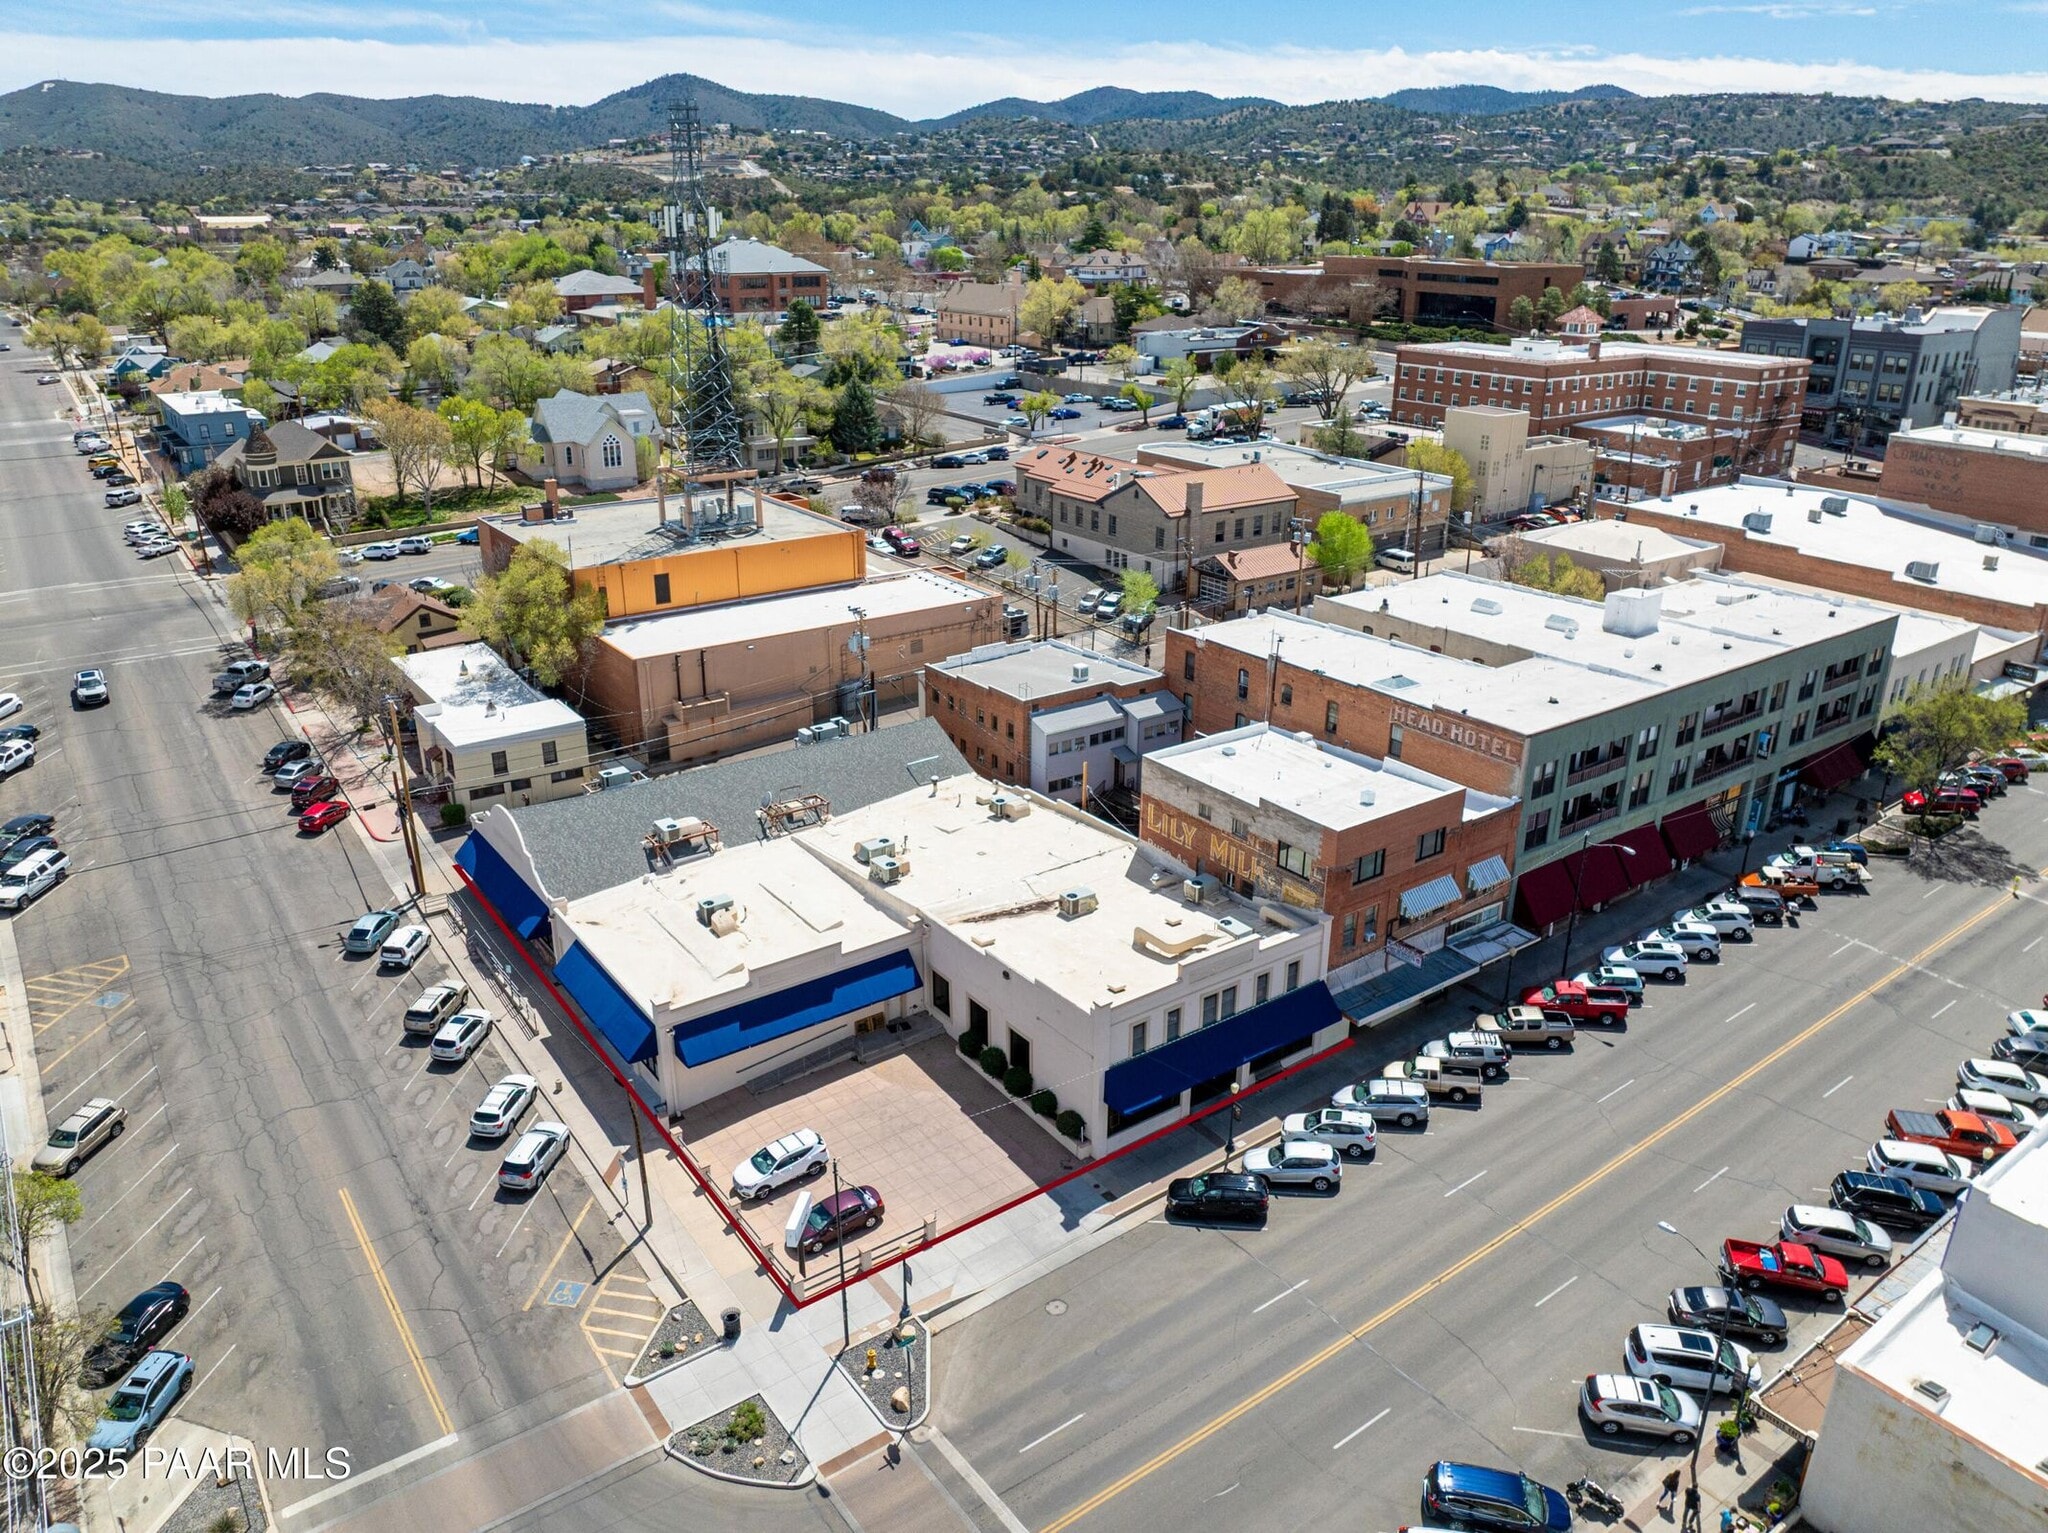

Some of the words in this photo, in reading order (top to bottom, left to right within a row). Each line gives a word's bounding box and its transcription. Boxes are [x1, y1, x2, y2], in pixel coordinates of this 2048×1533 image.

[1394, 705, 1444, 735] HEAD
[1450, 724, 1517, 762] HOTEL
[1147, 803, 1198, 850] LILY
